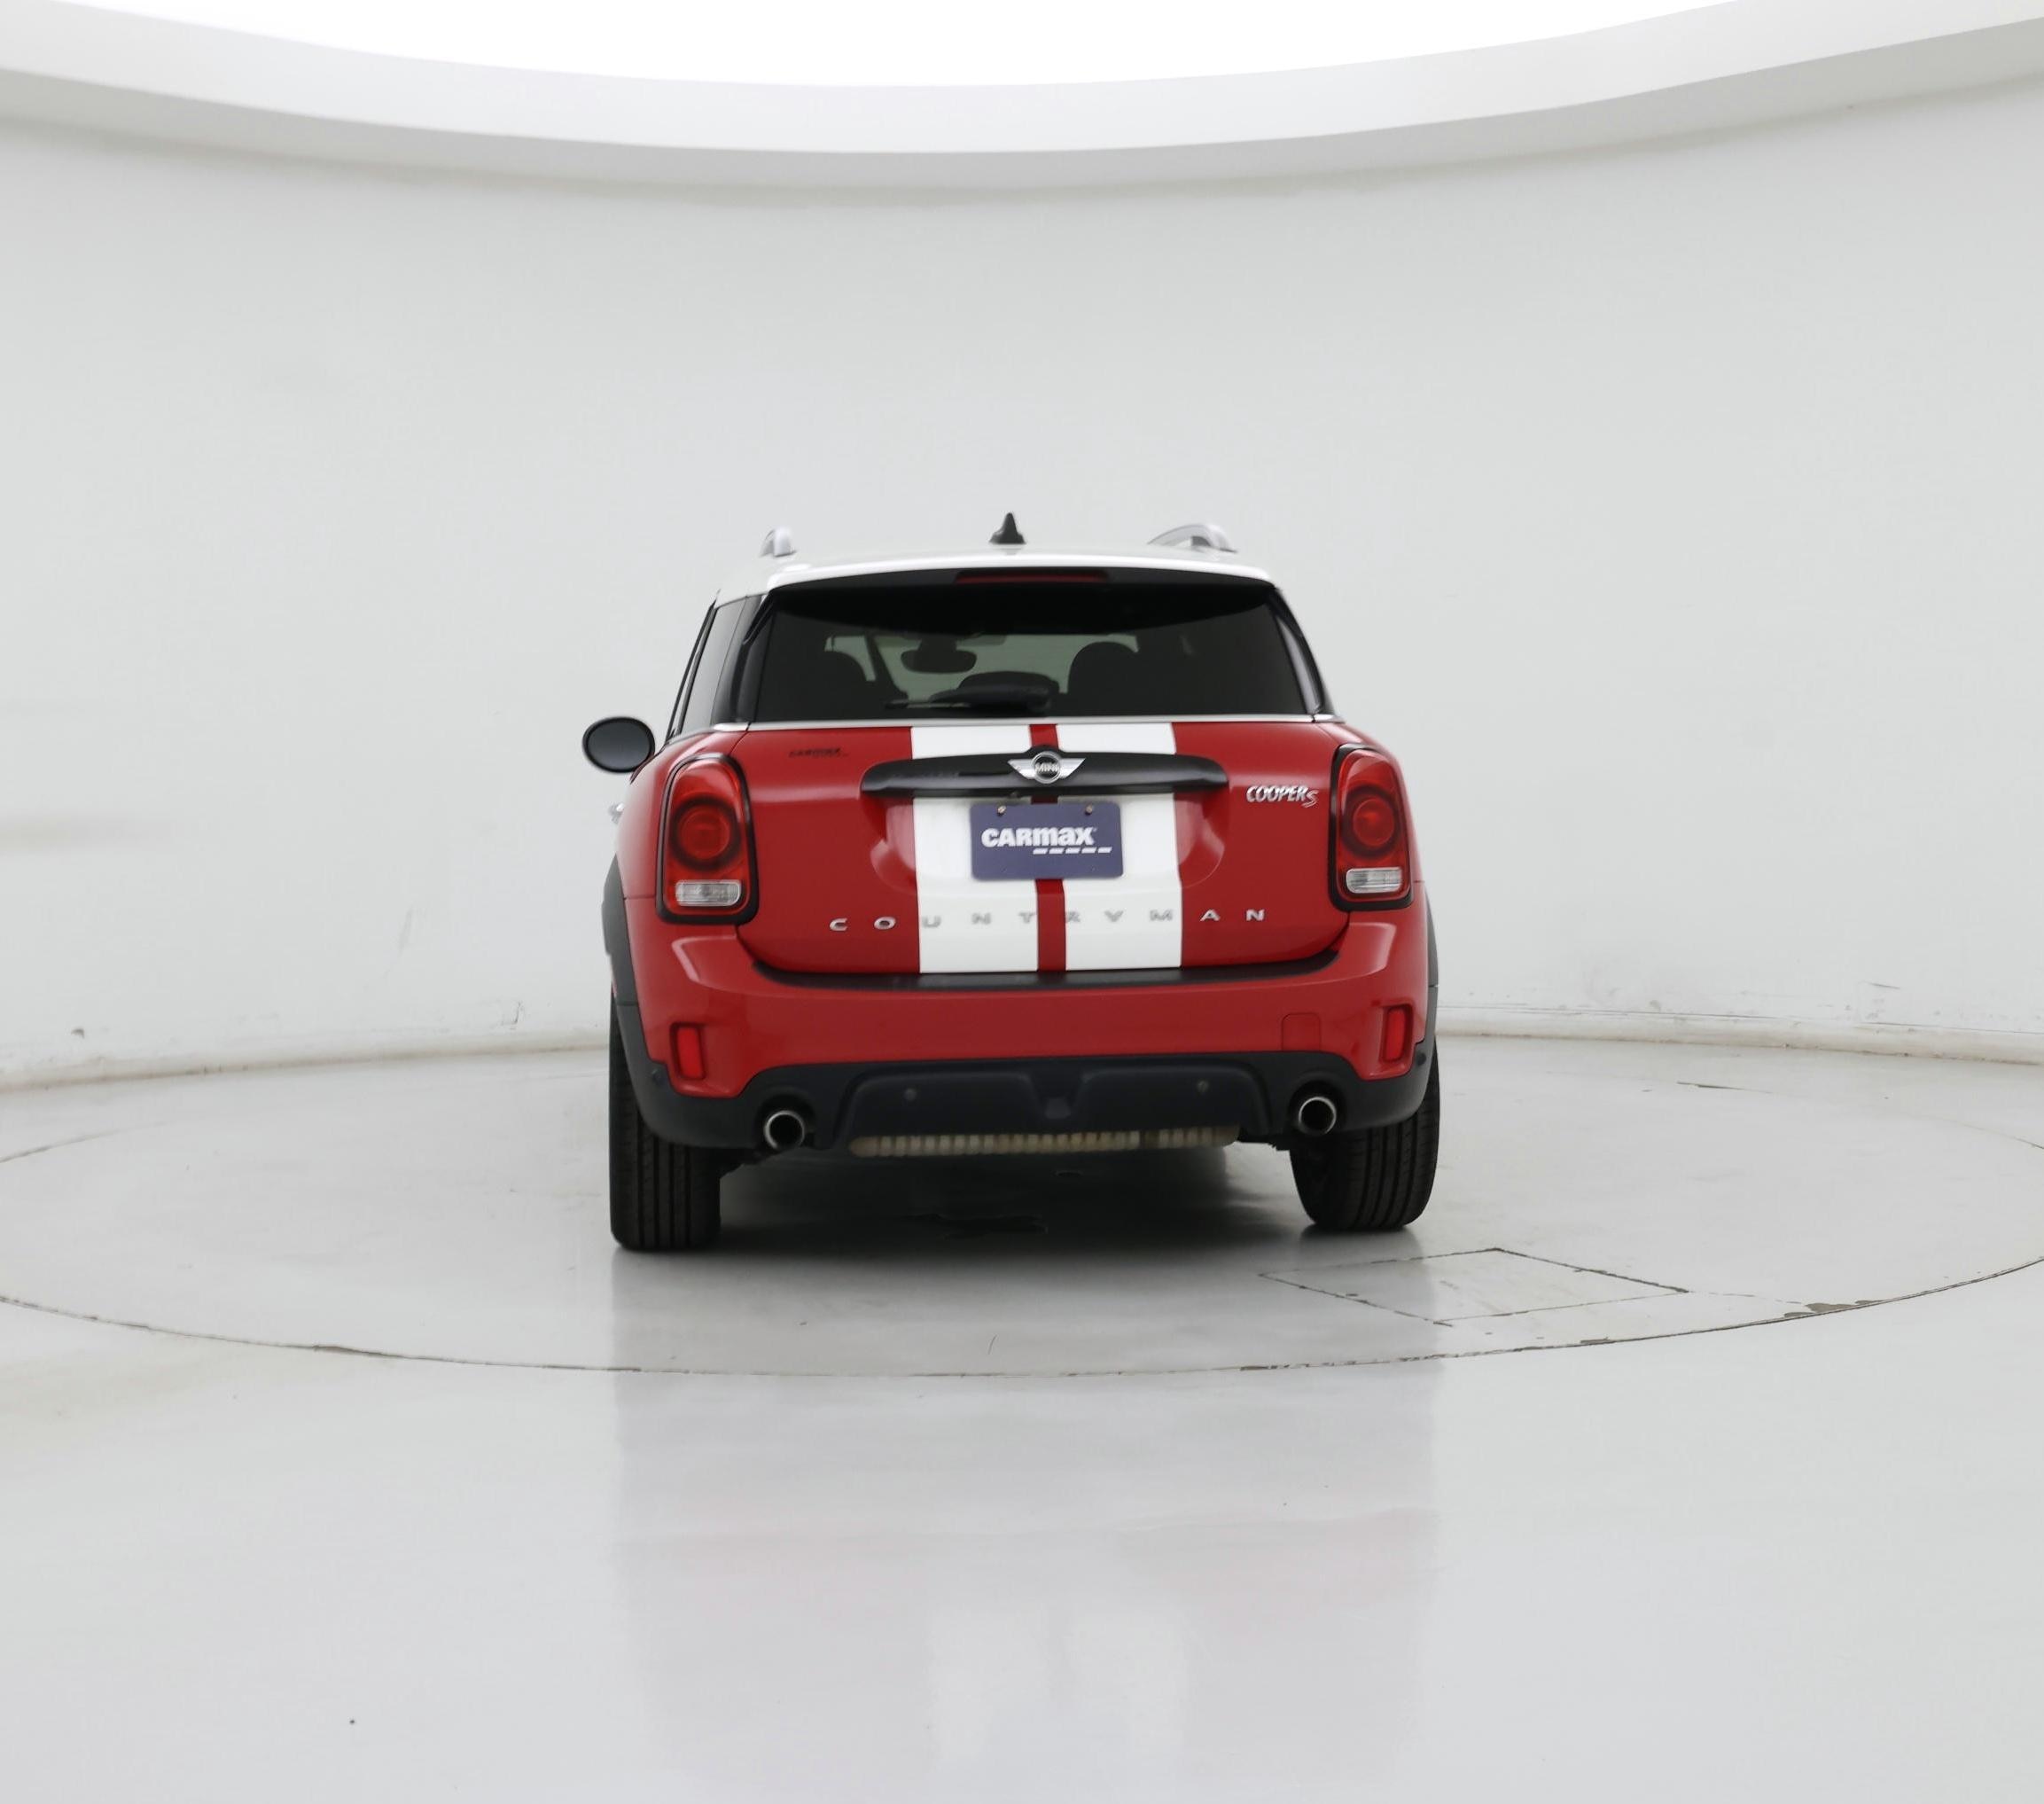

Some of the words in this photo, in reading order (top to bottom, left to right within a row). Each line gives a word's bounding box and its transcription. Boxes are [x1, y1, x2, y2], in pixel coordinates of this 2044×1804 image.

[1034, 762, 1059, 772] MINI
[1246, 785, 1308, 802] COOPER
[829, 909, 1265, 932] COUNTRYMAN
